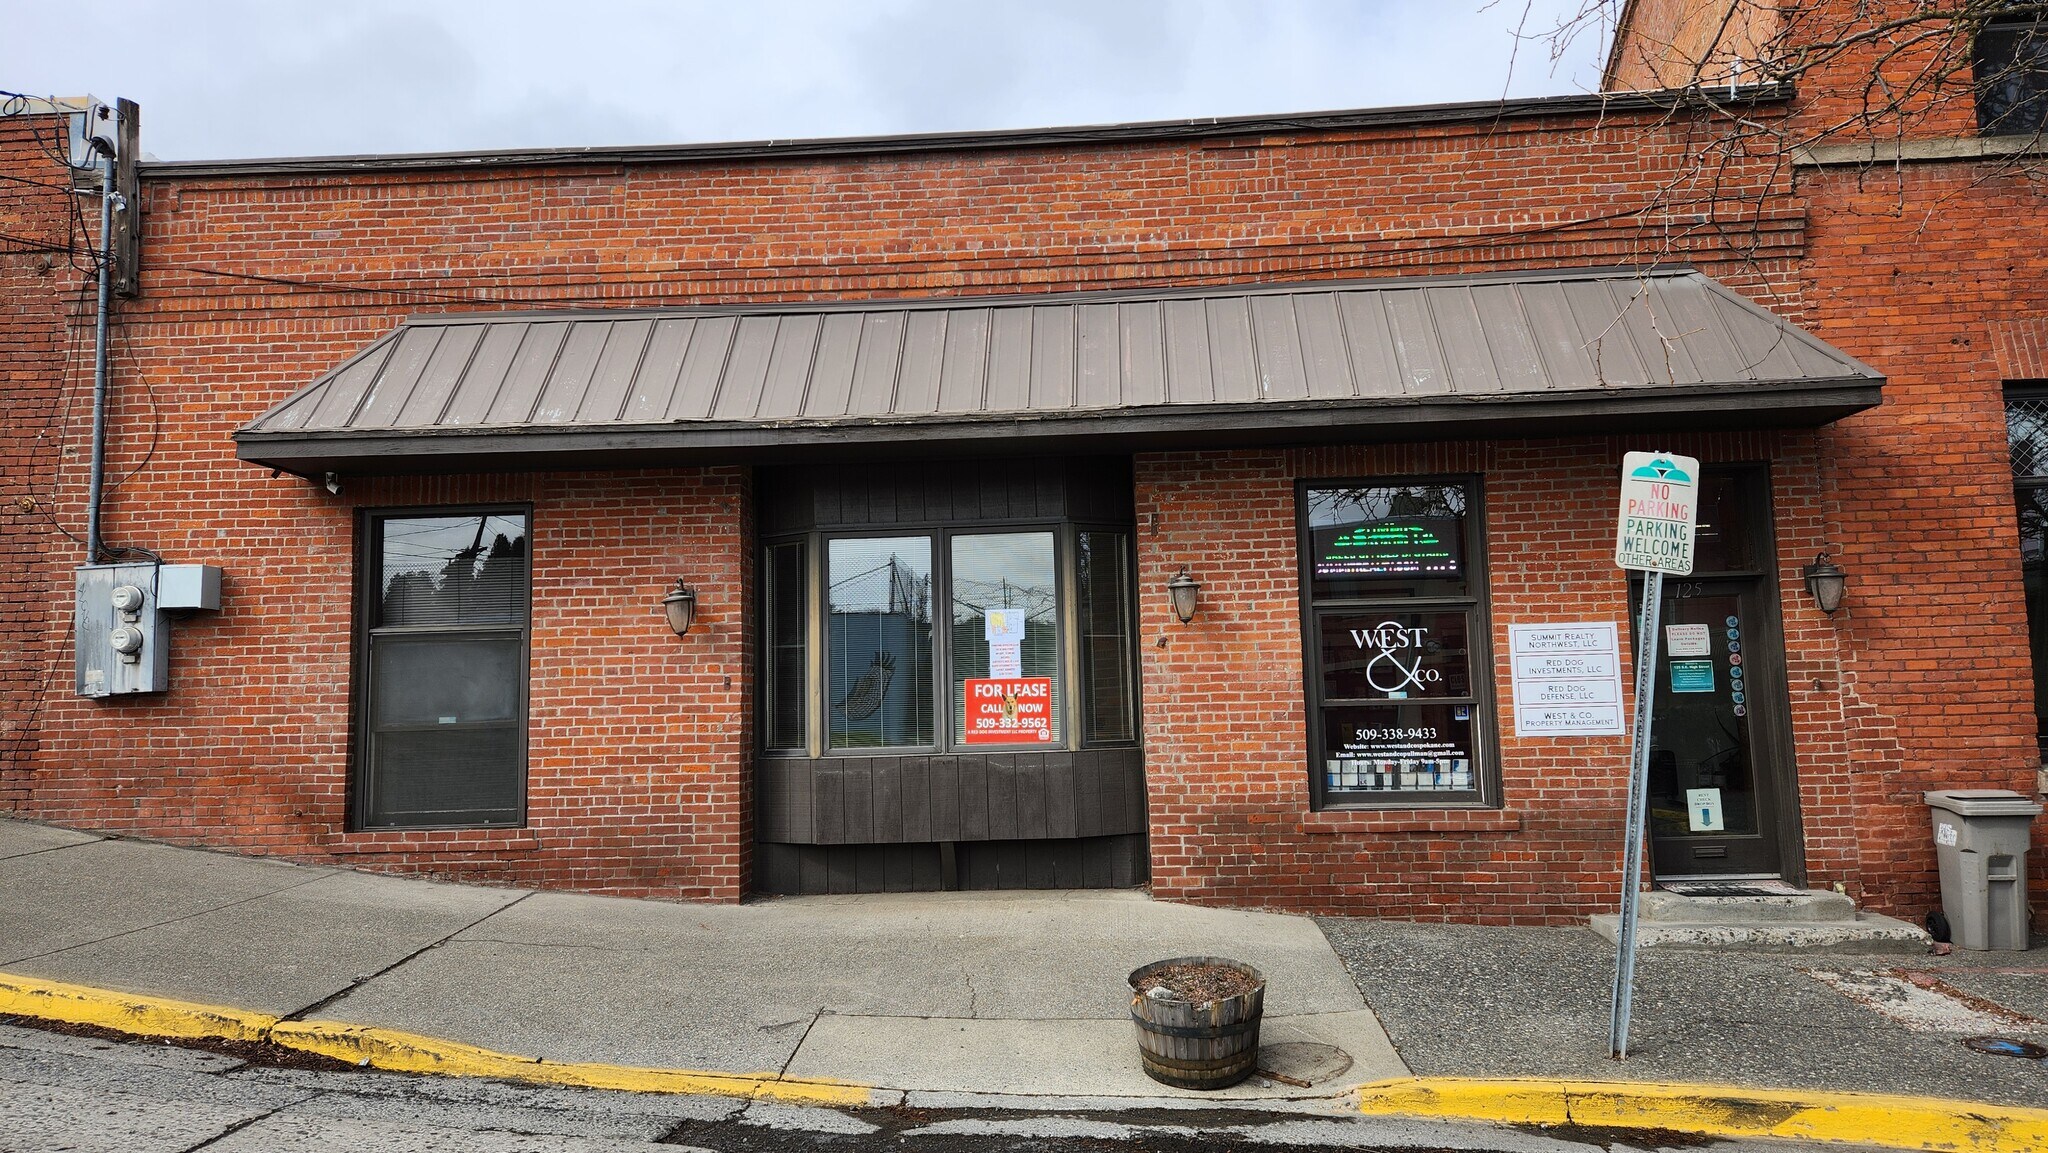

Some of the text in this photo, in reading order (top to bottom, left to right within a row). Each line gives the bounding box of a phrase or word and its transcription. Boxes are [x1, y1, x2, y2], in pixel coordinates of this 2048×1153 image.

[1651, 484, 1670, 500] NO
[1628, 499, 1688, 520] PARKING
[1627, 519, 1687, 540] PARKING
[1624, 536, 1689, 559] WELCOME
[1619, 553, 1691, 572] OTHER AREAS
[1675, 582, 1702, 599] 125
[1349, 628, 1428, 649] WEST
[1414, 669, 1443, 682] CO.
[1529, 667, 1584, 675] INVESTMENTS,
[975, 683, 1047, 697] FOR LEASE
[1540, 693, 1577, 701] DEFENSE,
[981, 703, 1043, 713] CALL NOW
[976, 718, 1047, 728] 509-332-9562
[1356, 727, 1437, 740] 509-338-9433
[1370, 742, 1455, 750] www.westandcospokane.com
[1356, 750, 1464, 758] www.westandcopullman@gmail.com
